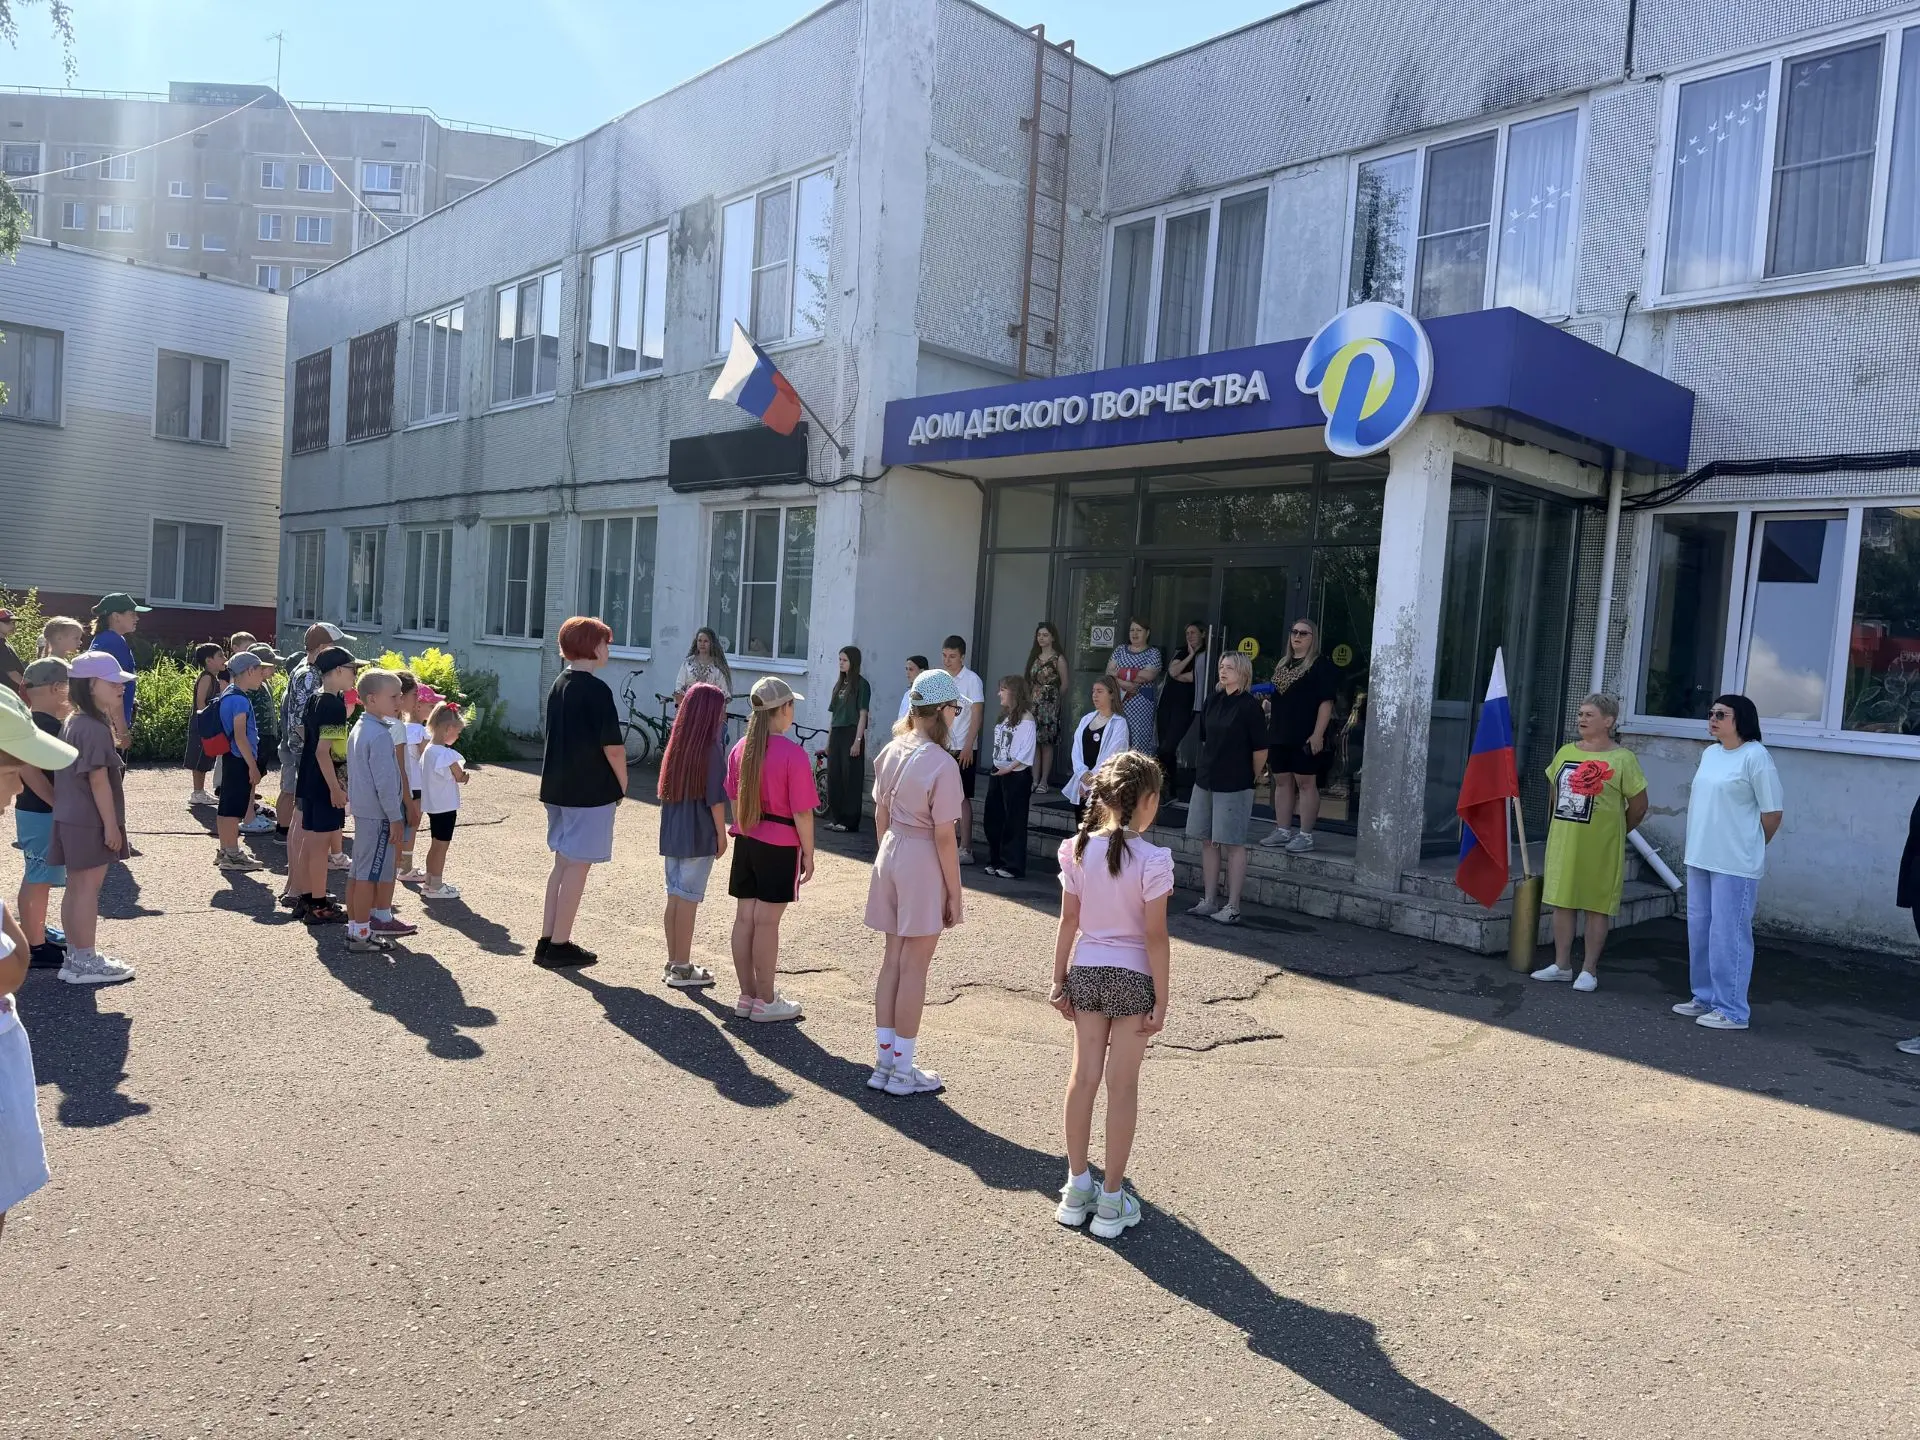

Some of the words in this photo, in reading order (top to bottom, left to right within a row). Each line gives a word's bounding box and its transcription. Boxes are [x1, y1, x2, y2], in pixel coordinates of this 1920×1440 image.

[908, 411, 965, 446] ДОМ
[963, 395, 1088, 440] ДЕТСКОГО
[1090, 370, 1270, 421] ТВОРЧЕСТВА
[372, 832, 388, 874] SUPERIOR
